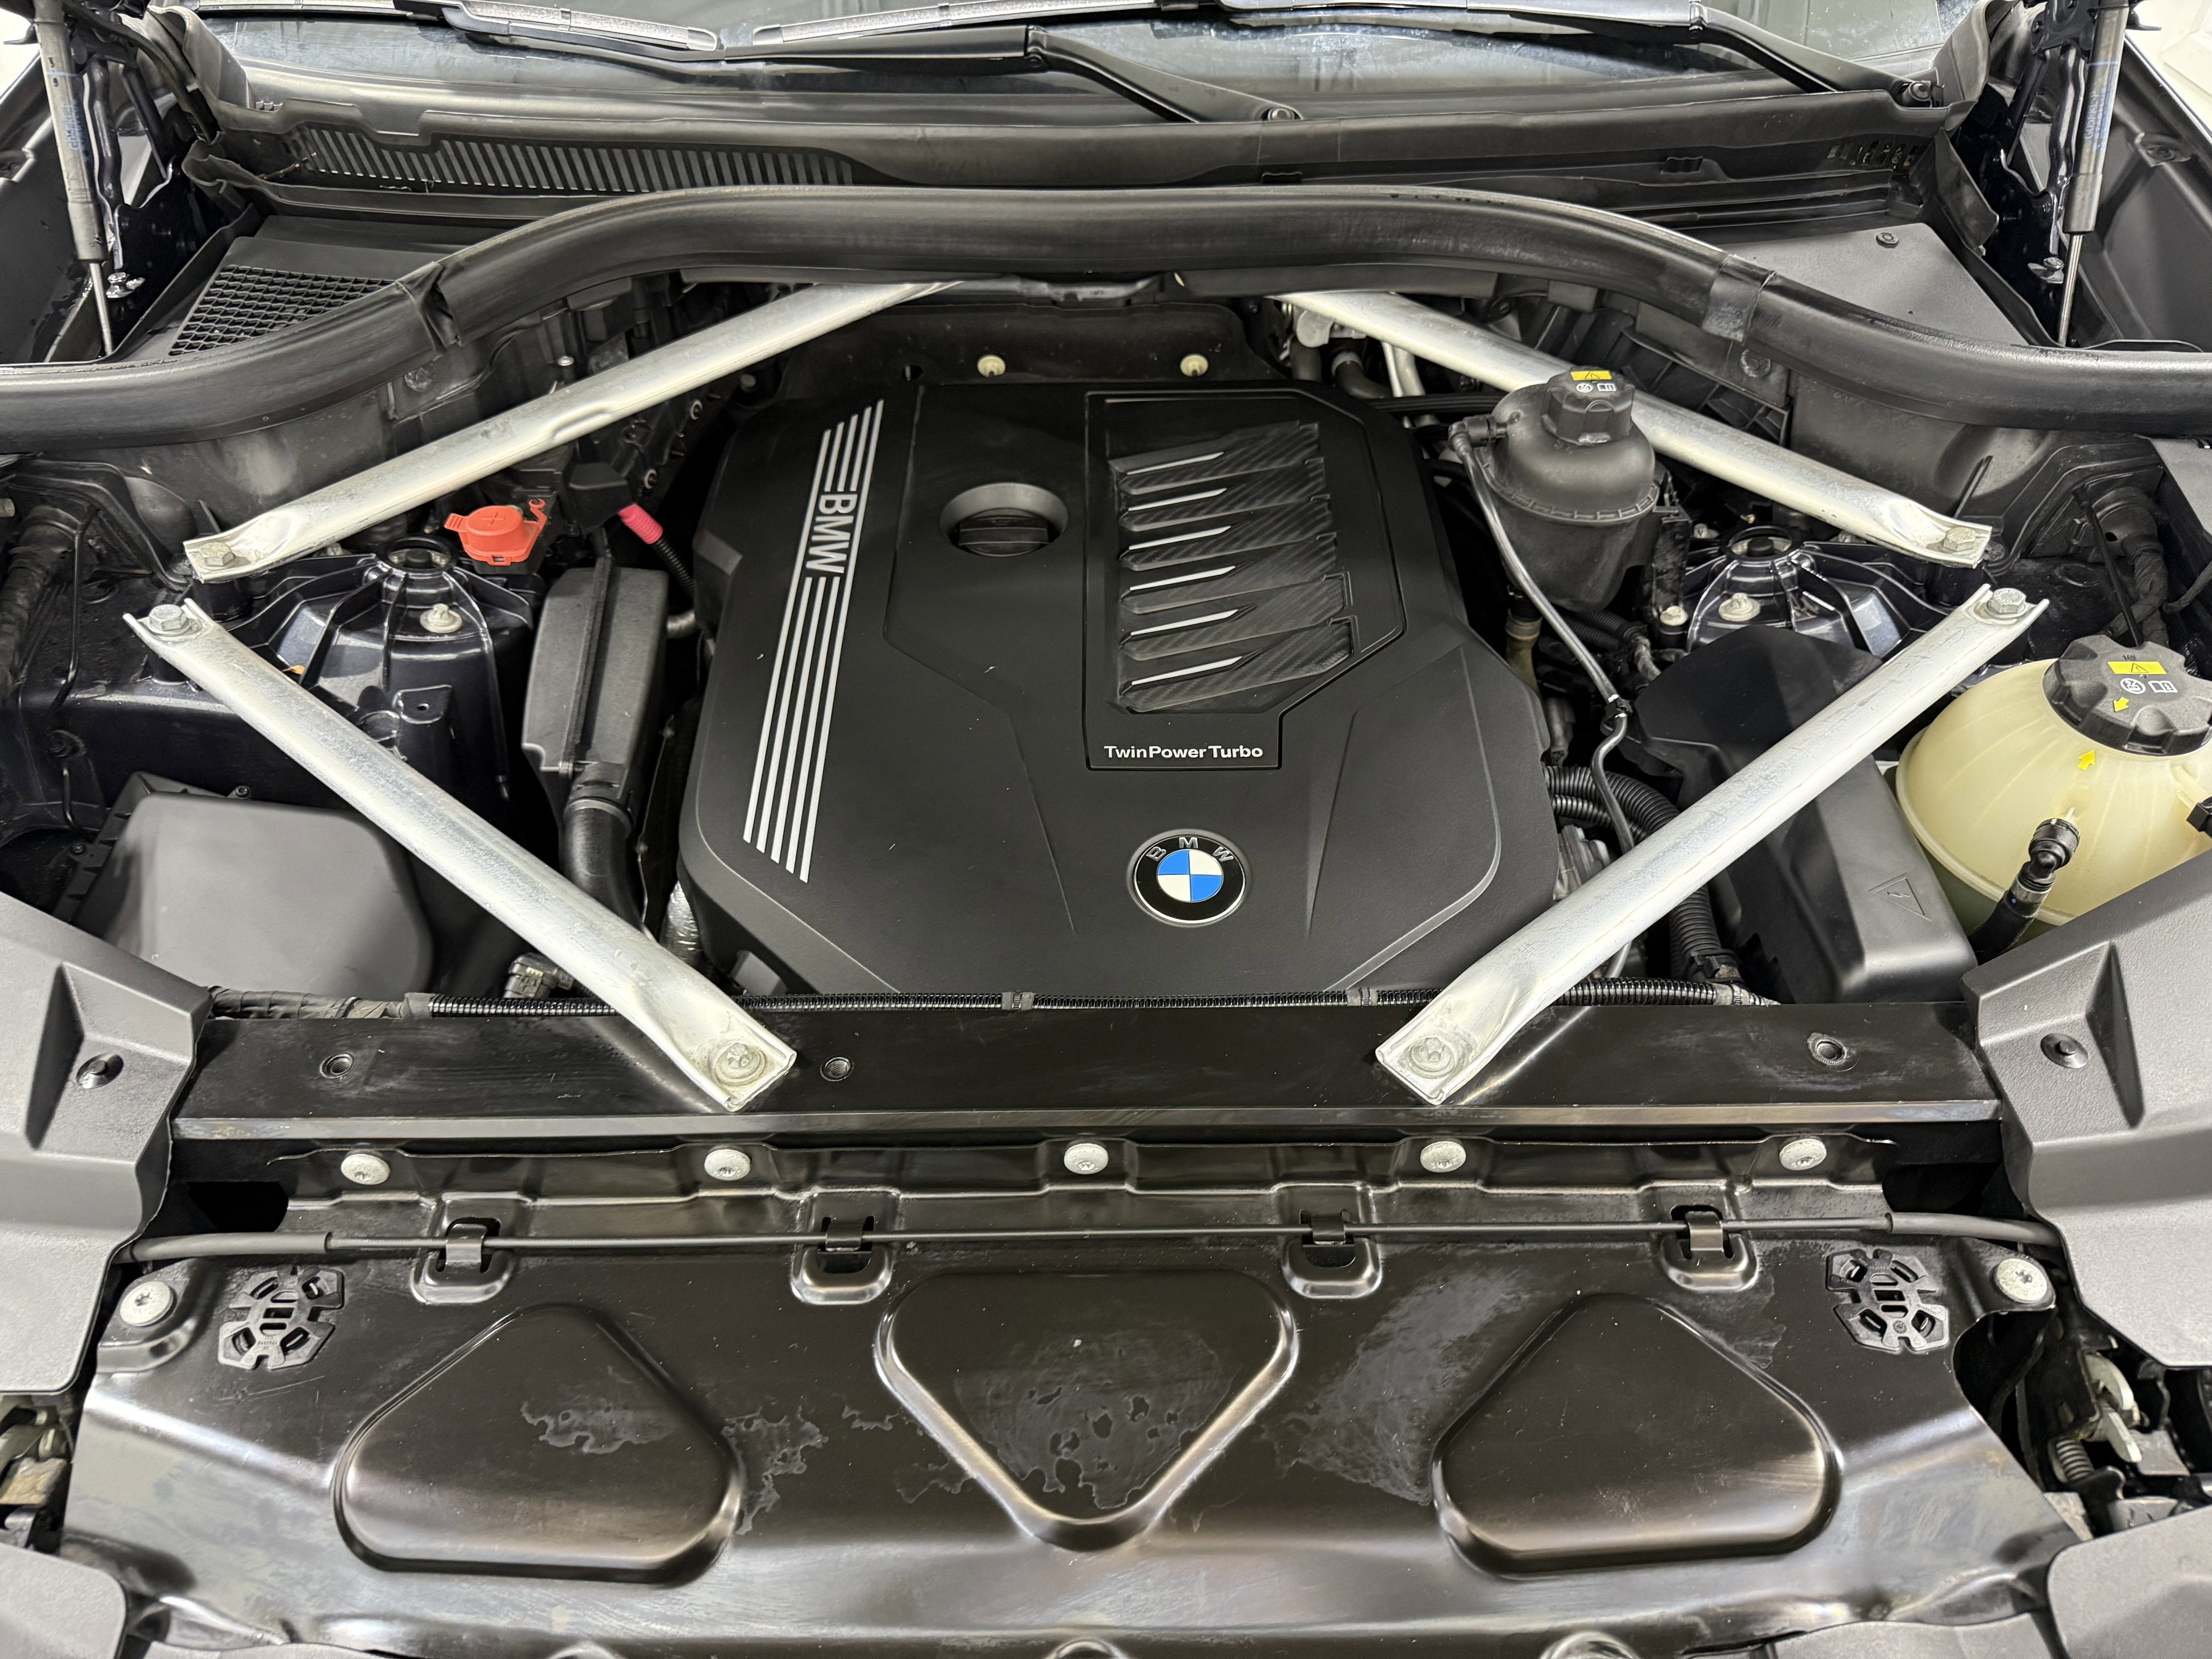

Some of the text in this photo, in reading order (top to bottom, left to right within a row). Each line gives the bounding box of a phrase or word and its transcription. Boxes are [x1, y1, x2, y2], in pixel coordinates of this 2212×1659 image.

[806, 494, 858, 574] BMW
[1104, 745, 1263, 758] TwinPower Turbo
[1146, 836, 1234, 862] BMW
